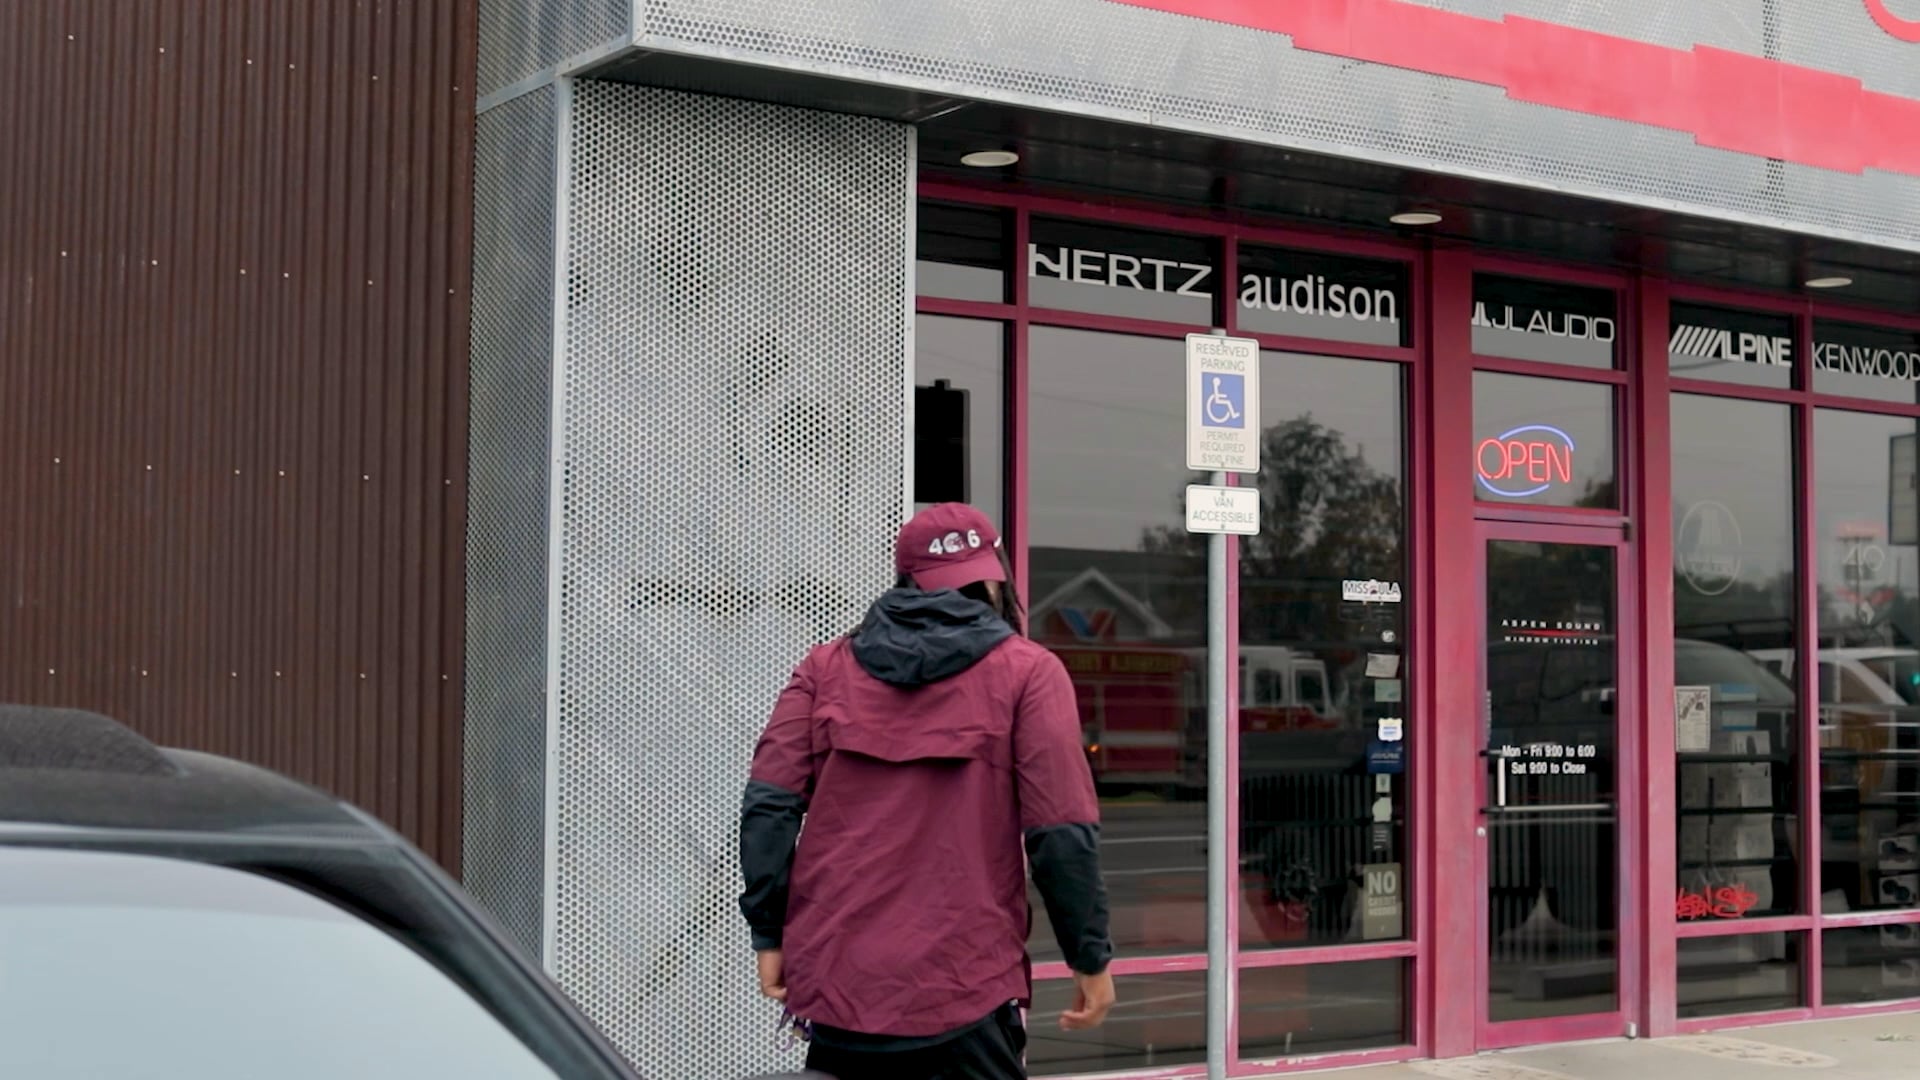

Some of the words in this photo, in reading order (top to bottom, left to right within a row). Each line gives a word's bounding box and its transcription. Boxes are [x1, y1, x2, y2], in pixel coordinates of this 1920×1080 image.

[1028, 243, 1212, 299] HERTZ
[1240, 273, 1396, 324] audison
[1491, 305, 1525, 332] JL
[1526, 310, 1615, 343] AUDIO
[1195, 343, 1249, 358] RESERVED
[1200, 357, 1245, 372] PARKING
[1811, 342, 1920, 381] KENWOOD
[1206, 431, 1239, 442] PERMIT
[1200, 441, 1245, 453] REQUIRED
[1225, 454, 1244, 465] FINE
[1477, 438, 1572, 483] OPEN
[1213, 497, 1234, 508] VAN
[1192, 510, 1255, 524] ACCESSIBLE
[1502, 619, 1547, 629] ASPEN
[1556, 621, 1600, 630] SOUND
[1502, 745, 1521, 757] Mon
[1530, 745, 1542, 757] Fri
[1545, 745, 1563, 757] 9:00
[1565, 746, 1575, 757] to
[1511, 762, 1527, 774] Sat
[1550, 762, 1560, 774] to
[1562, 762, 1586, 774] Close
[1368, 870, 1396, 895] NO
